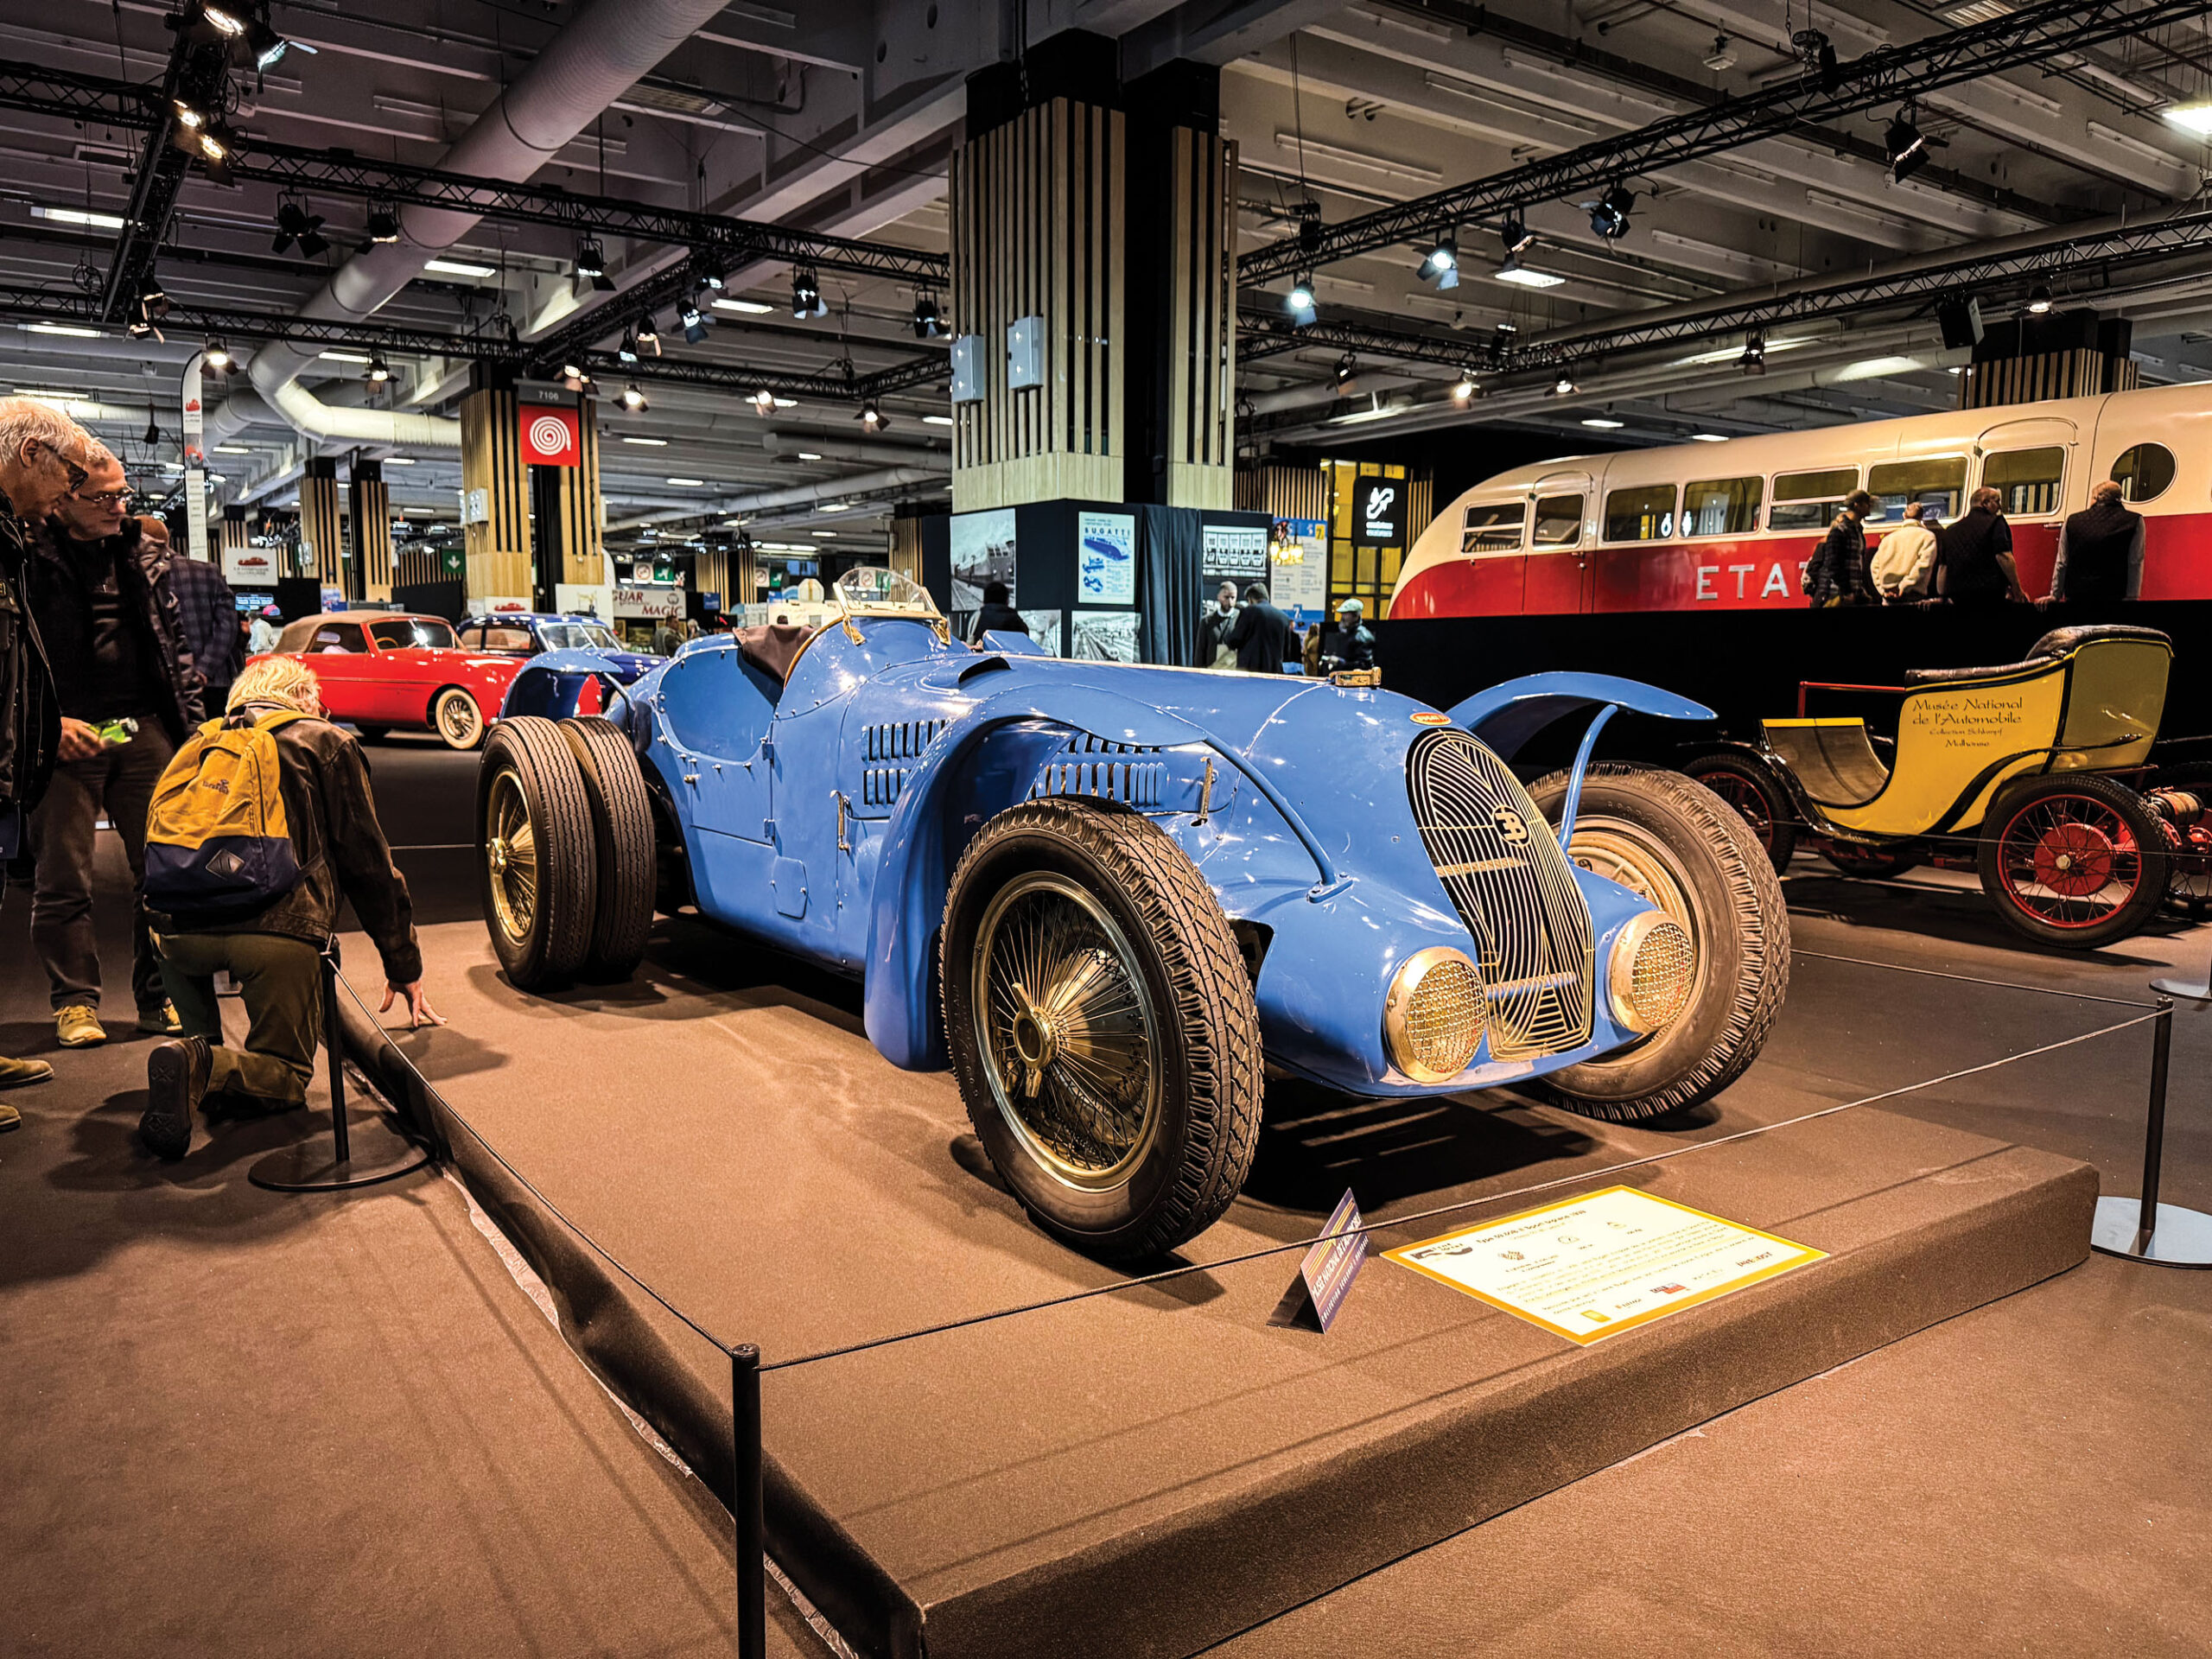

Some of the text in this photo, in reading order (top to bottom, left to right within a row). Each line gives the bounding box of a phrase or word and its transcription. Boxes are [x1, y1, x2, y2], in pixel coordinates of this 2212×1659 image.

[1084, 526, 1130, 537] BUGATTI
[1696, 562, 1809, 601] ETA
[613, 589, 644, 603] GUAR
[642, 605, 683, 617] MAGIC
[1912, 696, 2023, 712] Musée National
[1912, 711, 2023, 726] de l'Automobile
[1321, 1249, 1339, 1285] NATIONAL
